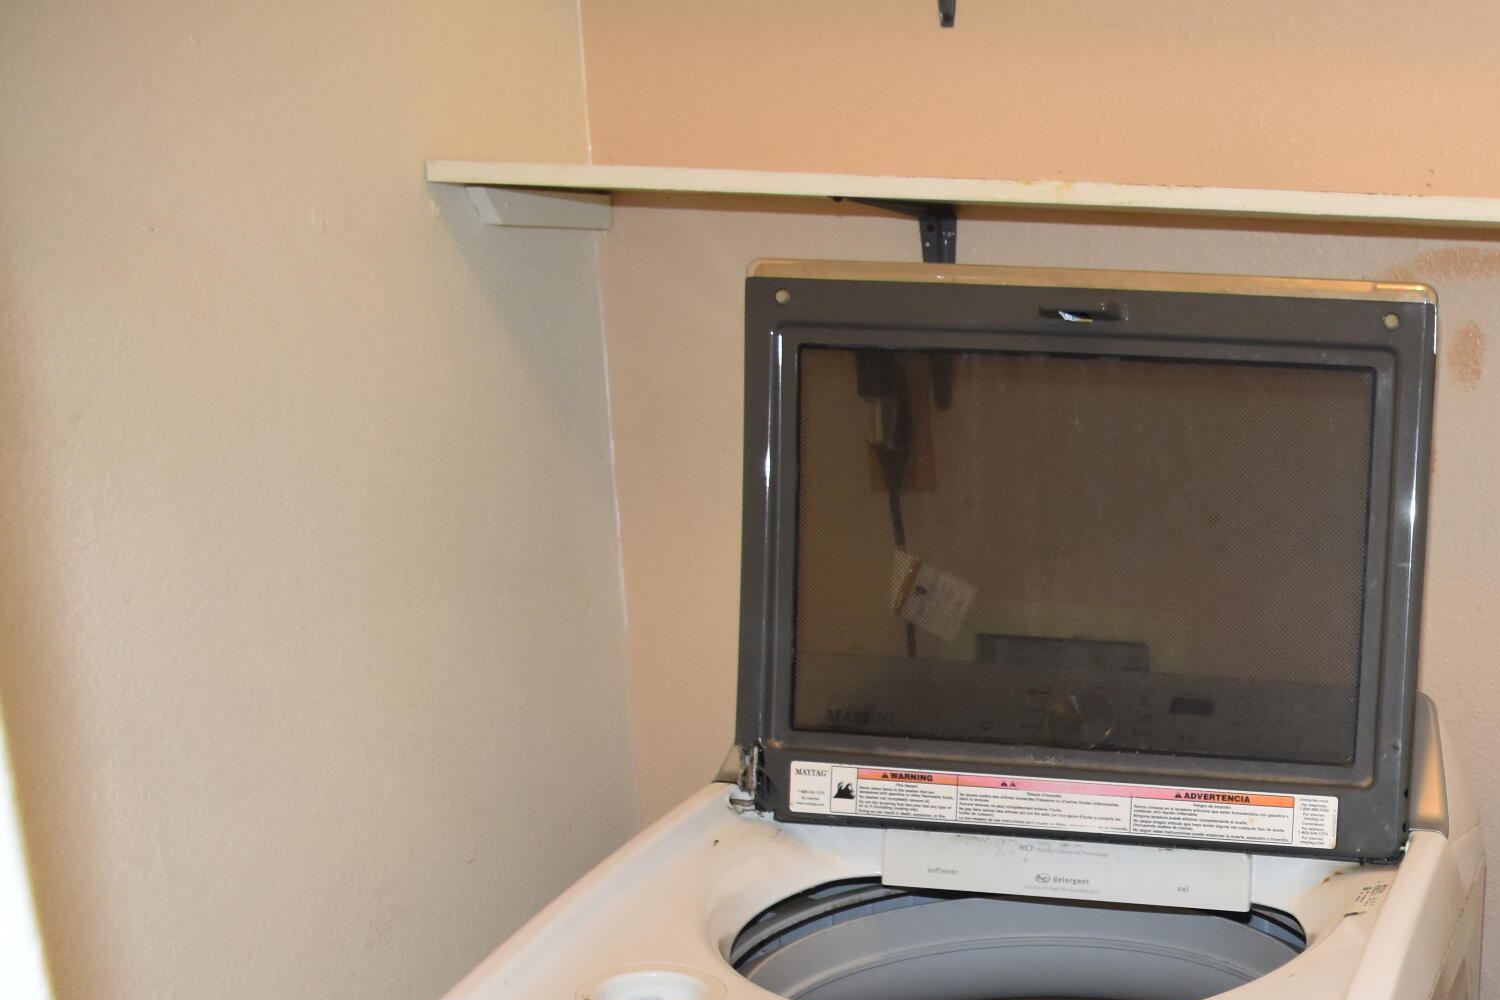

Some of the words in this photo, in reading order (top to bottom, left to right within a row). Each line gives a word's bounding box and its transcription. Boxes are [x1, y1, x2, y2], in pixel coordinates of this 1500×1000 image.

[795, 768, 827, 777] MAYTAG
[890, 772, 934, 782] WARNING
[1184, 792, 1250, 804] ADVERTENCIA
[1052, 876, 1090, 886] detergent
